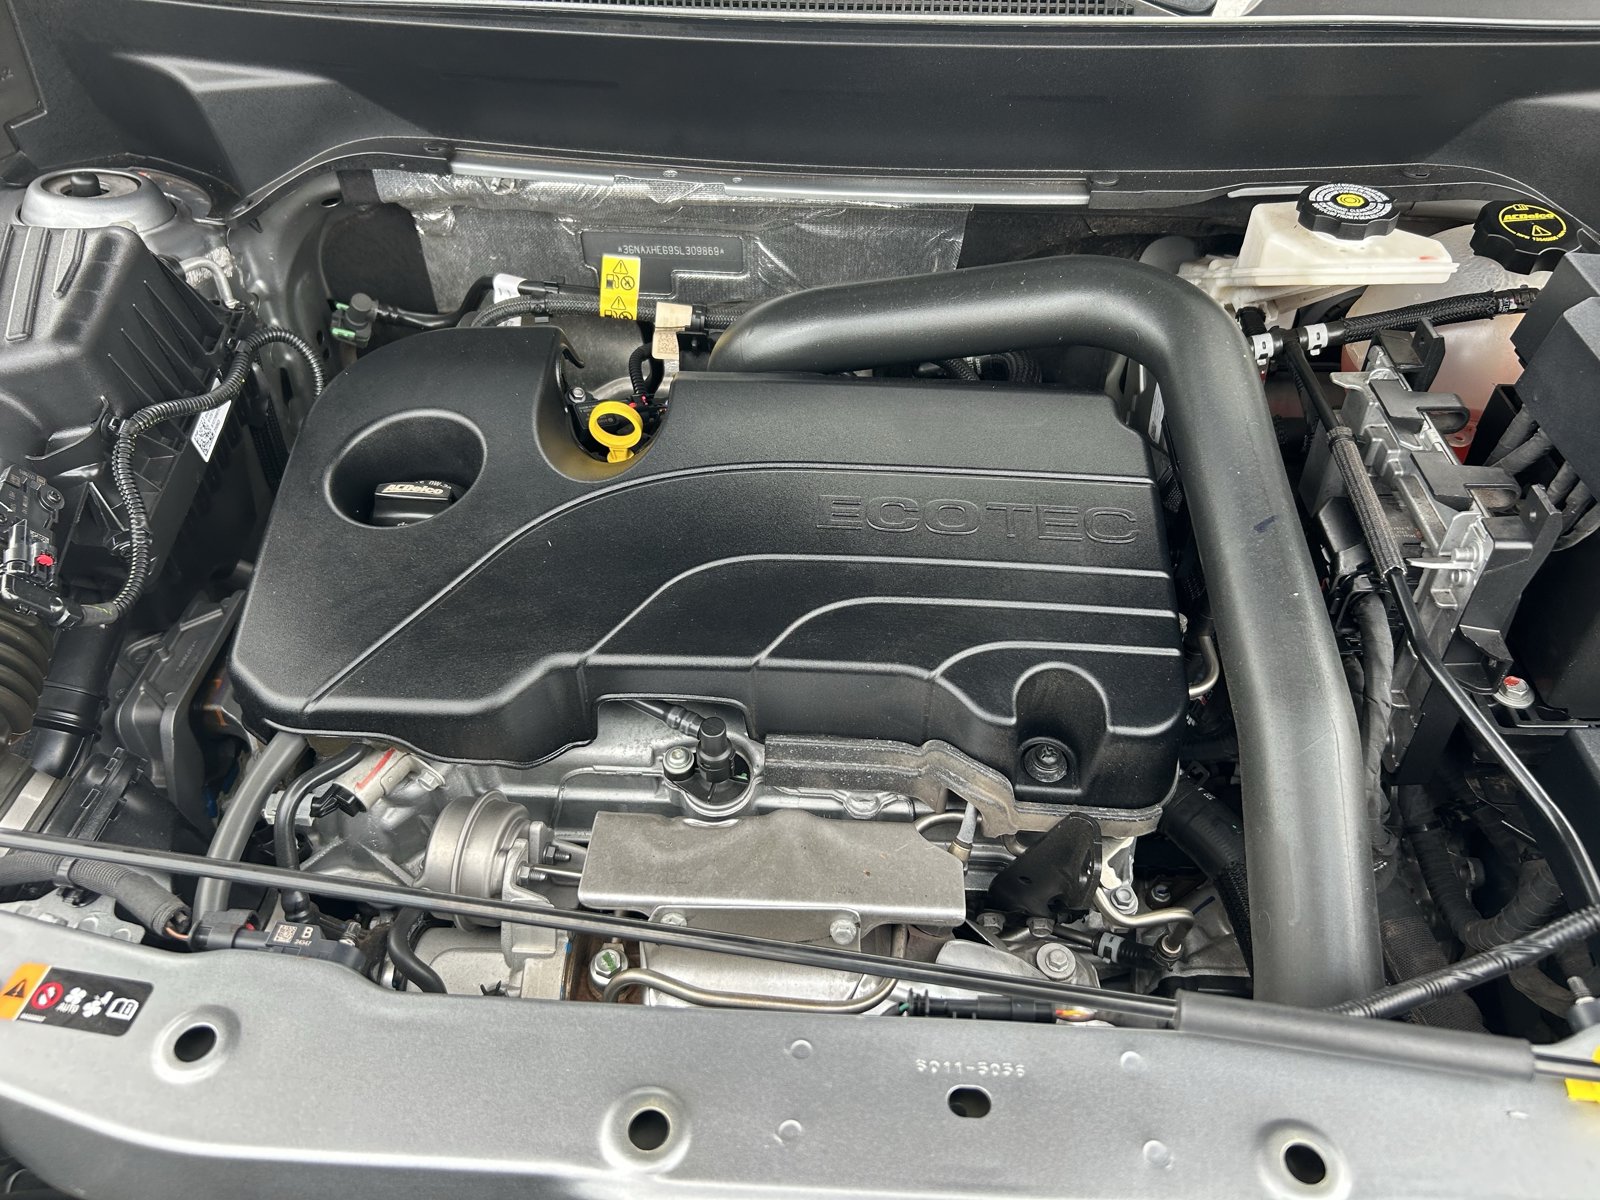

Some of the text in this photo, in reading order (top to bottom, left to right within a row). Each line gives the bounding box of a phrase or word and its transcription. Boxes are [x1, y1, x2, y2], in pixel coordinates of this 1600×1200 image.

[1502, 213, 1555, 222] ACDelco
[381, 484, 444, 495] ACDelco
[816, 494, 1140, 544] ECOTEC
[301, 926, 314, 939] B
[55, 1001, 81, 1015] AUTO
